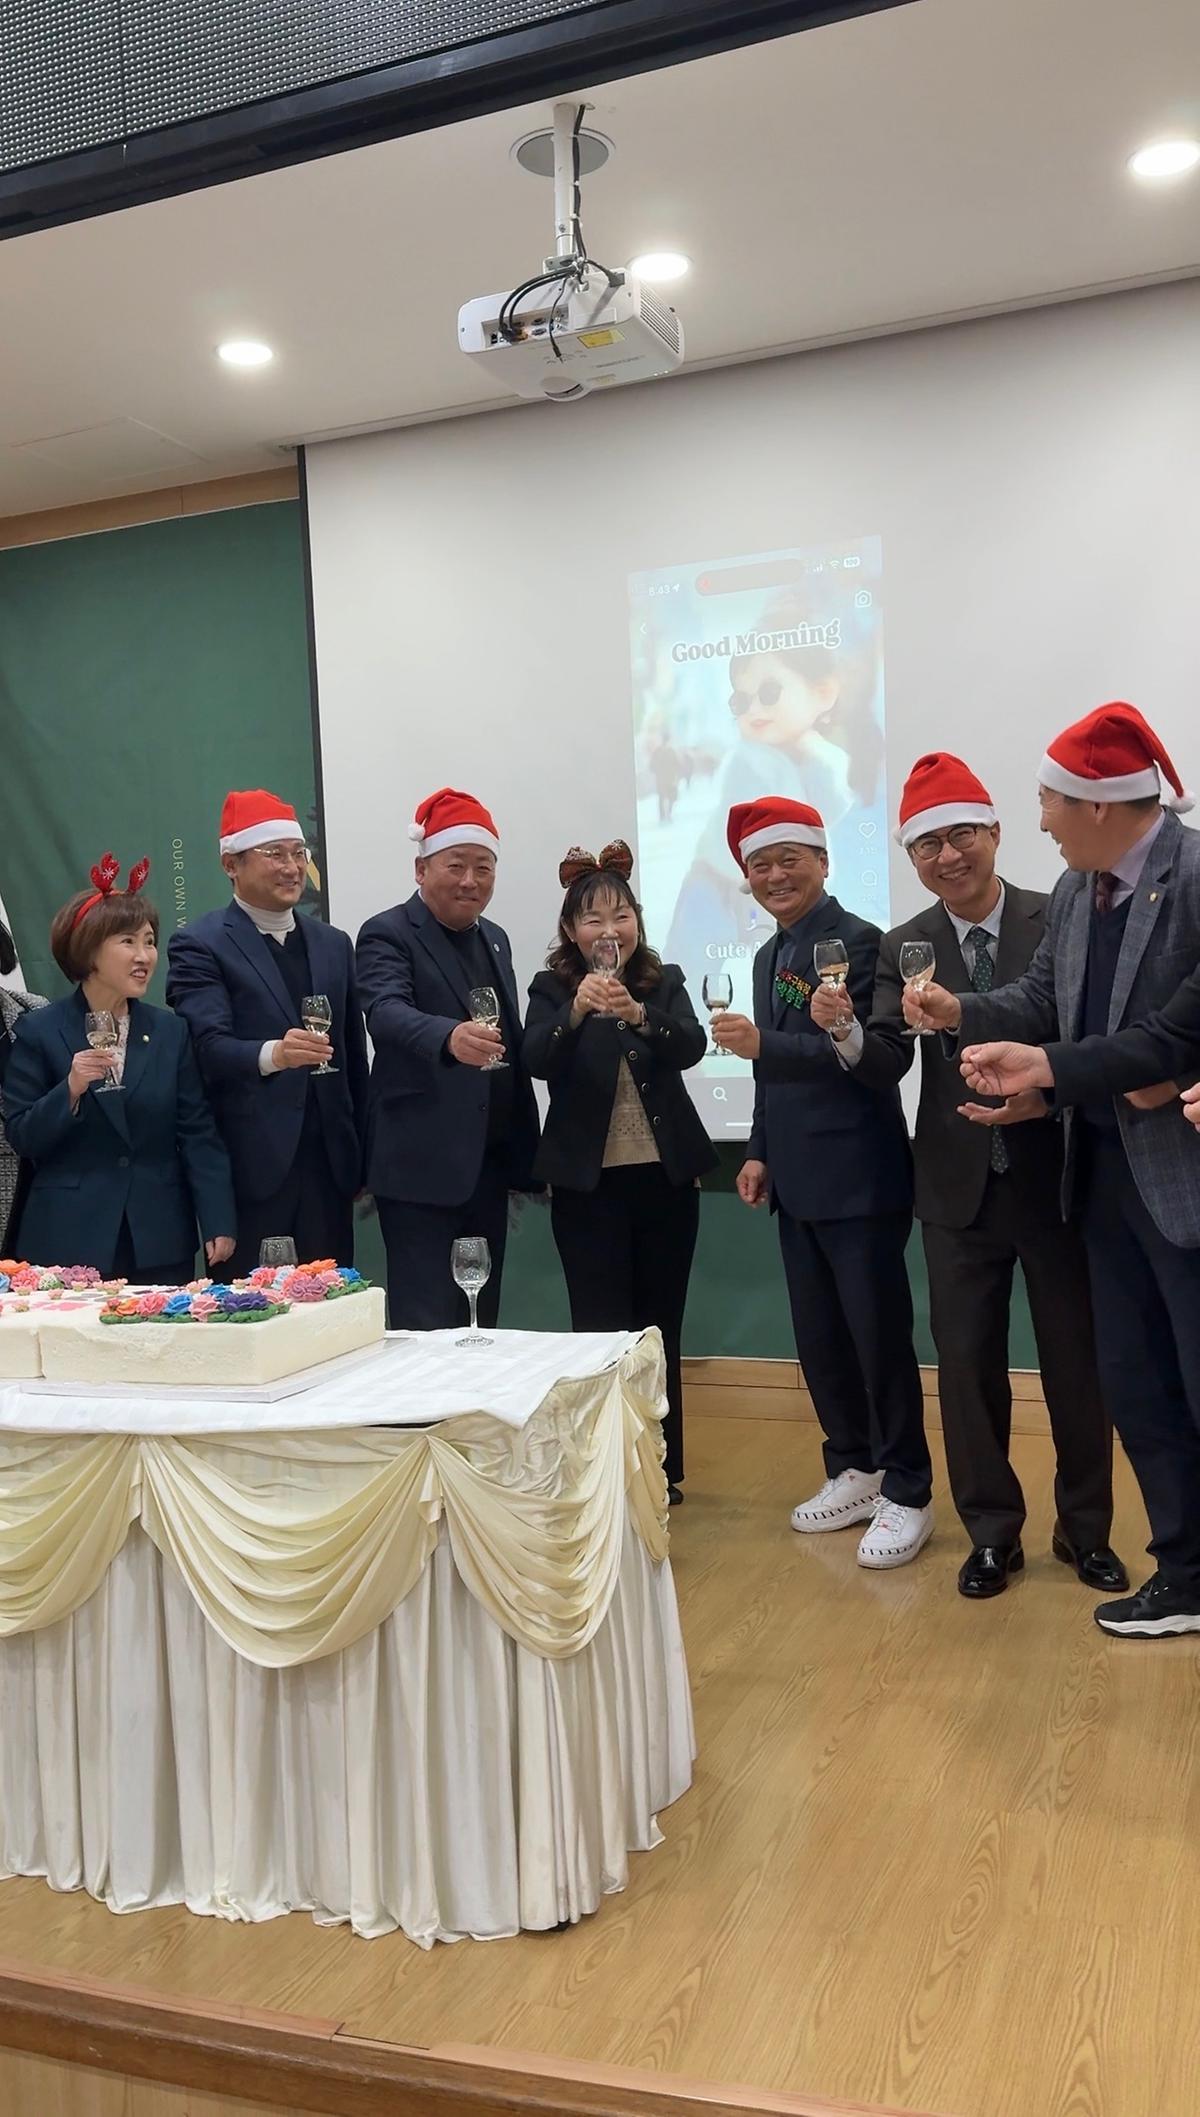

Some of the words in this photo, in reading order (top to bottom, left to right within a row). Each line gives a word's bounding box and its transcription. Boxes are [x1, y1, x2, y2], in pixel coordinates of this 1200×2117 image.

[671, 635, 732, 663] Good
[735, 619, 841, 656] Morning
[172, 838, 184, 870] OUR
[174, 876, 186, 911] OWN
[705, 942, 746, 960] Cute
